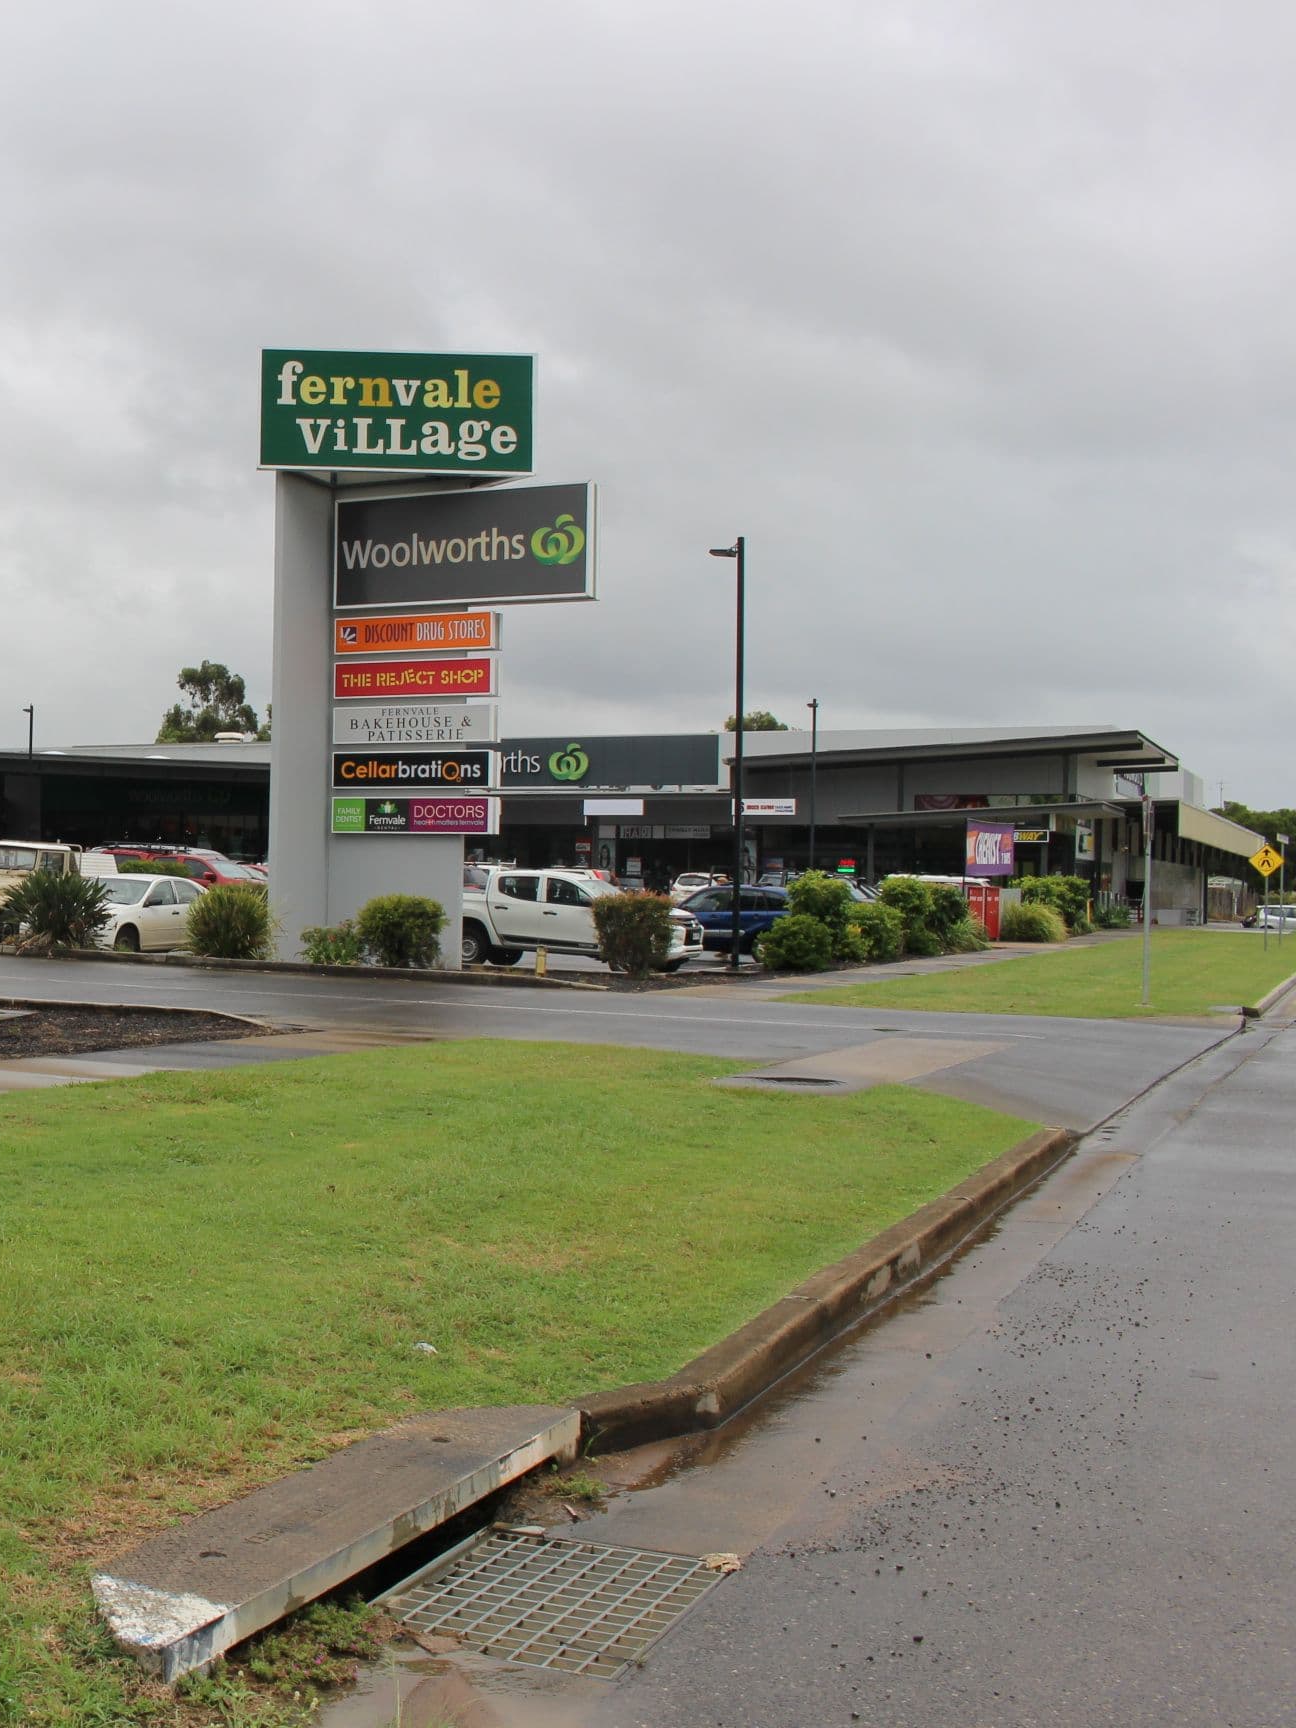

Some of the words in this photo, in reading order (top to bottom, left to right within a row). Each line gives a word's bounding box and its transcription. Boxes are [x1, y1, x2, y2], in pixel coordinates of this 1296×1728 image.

[276, 360, 501, 409] fernvale
[342, 527, 526, 570] Woolworths
[364, 622, 415, 644] DISCOUNT
[416, 621, 444, 642] DRUG
[448, 619, 487, 640] STORES
[342, 674, 371, 688] THE
[376, 669, 435, 687] REJECT
[440, 669, 484, 685] SHOP
[381, 706, 439, 716] FERNVALE
[350, 716, 453, 730] BAKEHOUSE
[461, 716, 472, 727] &
[368, 728, 464, 741] PATISSERIE
[503, 750, 541, 773] rths
[337, 807, 361, 815] FAMILY
[413, 805, 485, 818] DOCTORS
[335, 815, 362, 823] DENTIST
[369, 814, 406, 825] Fernvale
[459, 818, 484, 826] fernvale
[1014, 832, 1044, 841] BWAY
